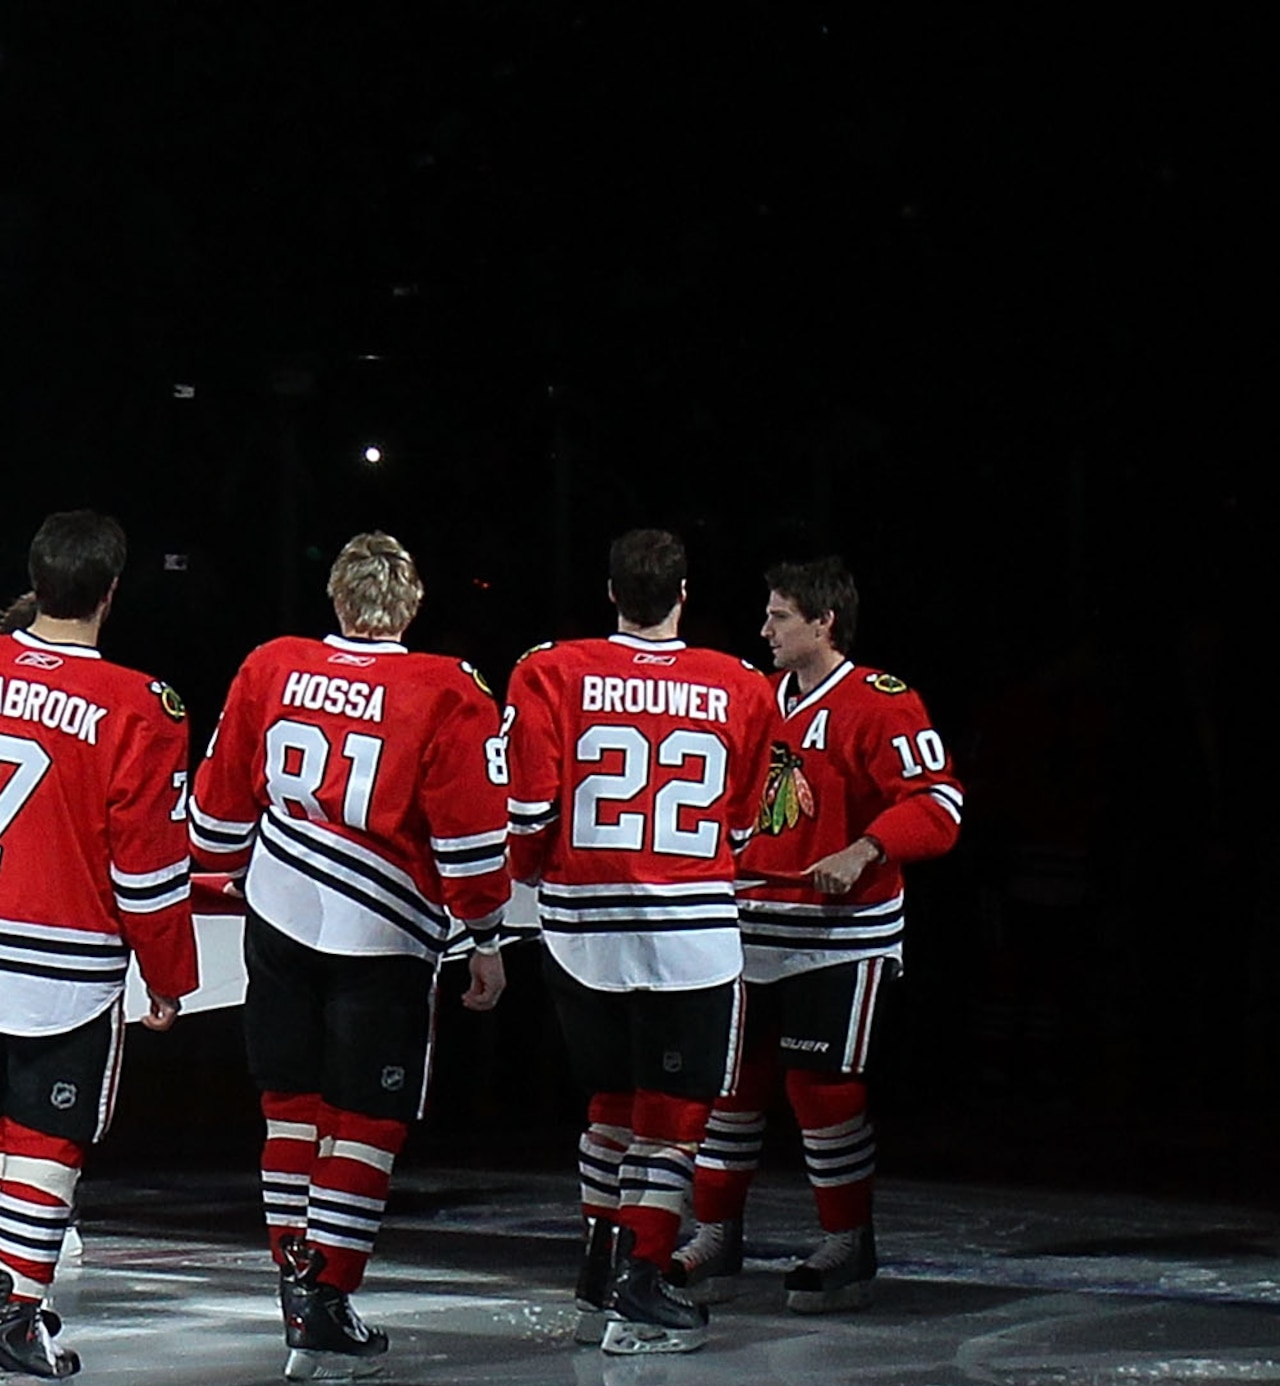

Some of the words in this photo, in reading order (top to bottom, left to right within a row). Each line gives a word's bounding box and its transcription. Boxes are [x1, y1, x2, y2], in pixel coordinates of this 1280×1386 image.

[282, 671, 385, 724] HOSSA
[582, 675, 729, 724] BROUWER
[800, 708, 830, 751] A
[892, 728, 948, 779] 10
[264, 718, 384, 832] 81
[571, 725, 729, 859] 22
